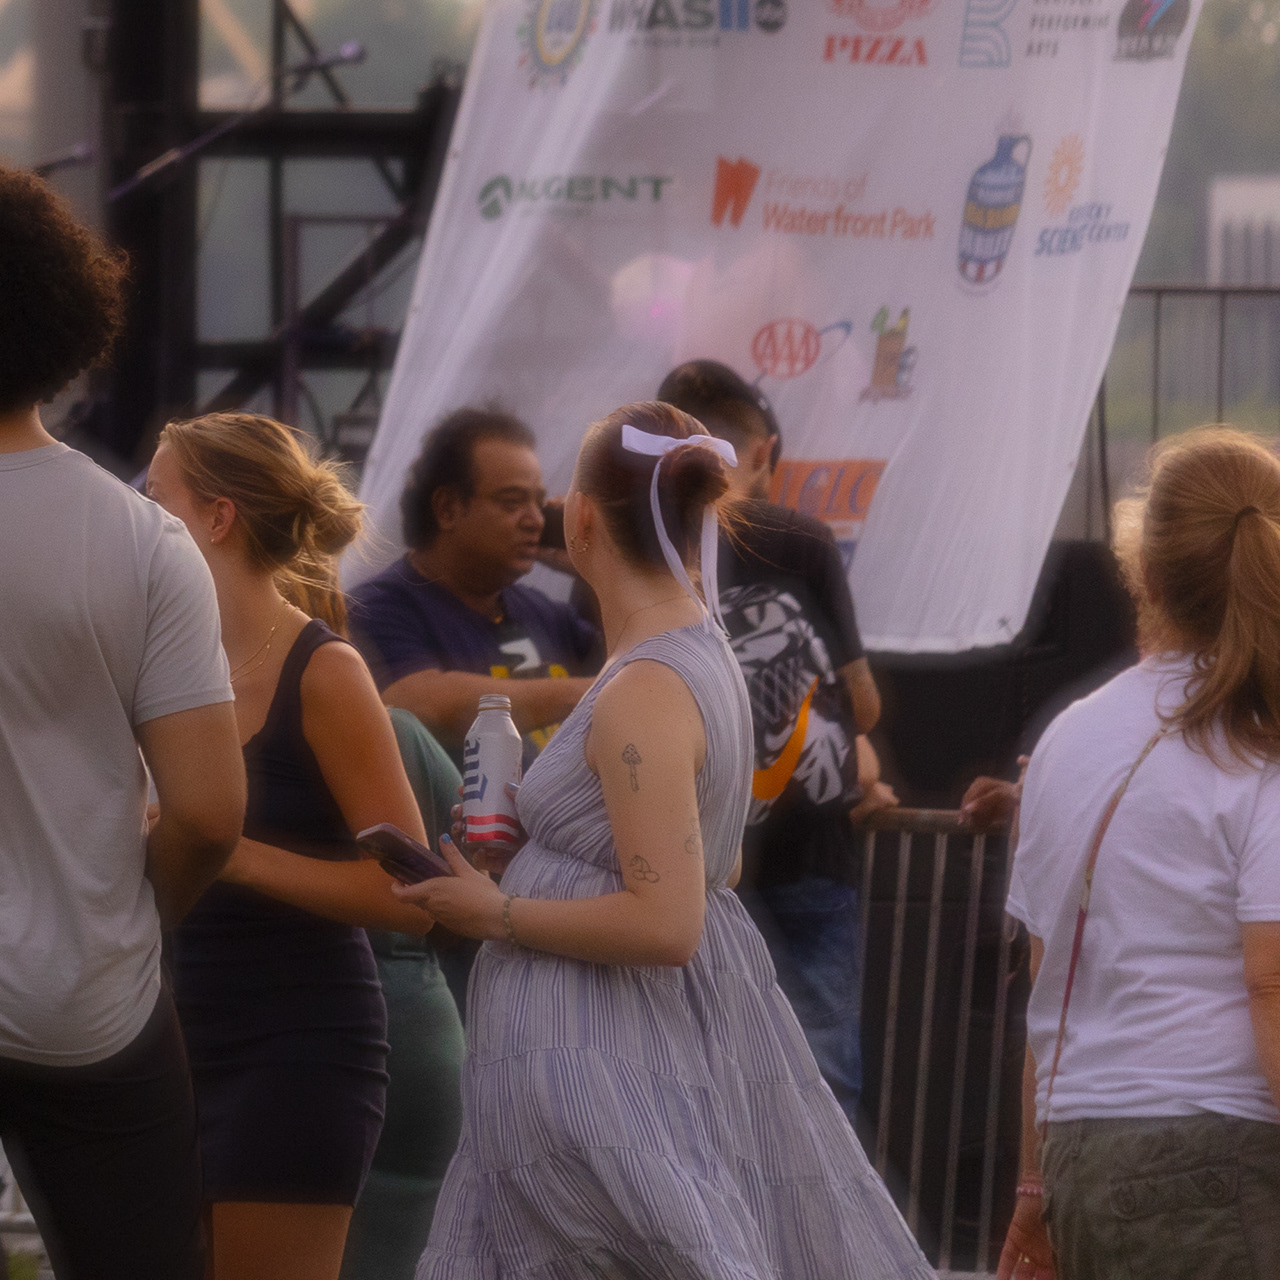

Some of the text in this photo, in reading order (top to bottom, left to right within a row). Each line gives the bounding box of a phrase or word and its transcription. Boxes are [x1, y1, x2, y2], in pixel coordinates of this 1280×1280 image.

[823, 34, 929, 66] PIZZA
[762, 202, 937, 241] Waterfront Park
[754, 320, 820, 381] AAA
